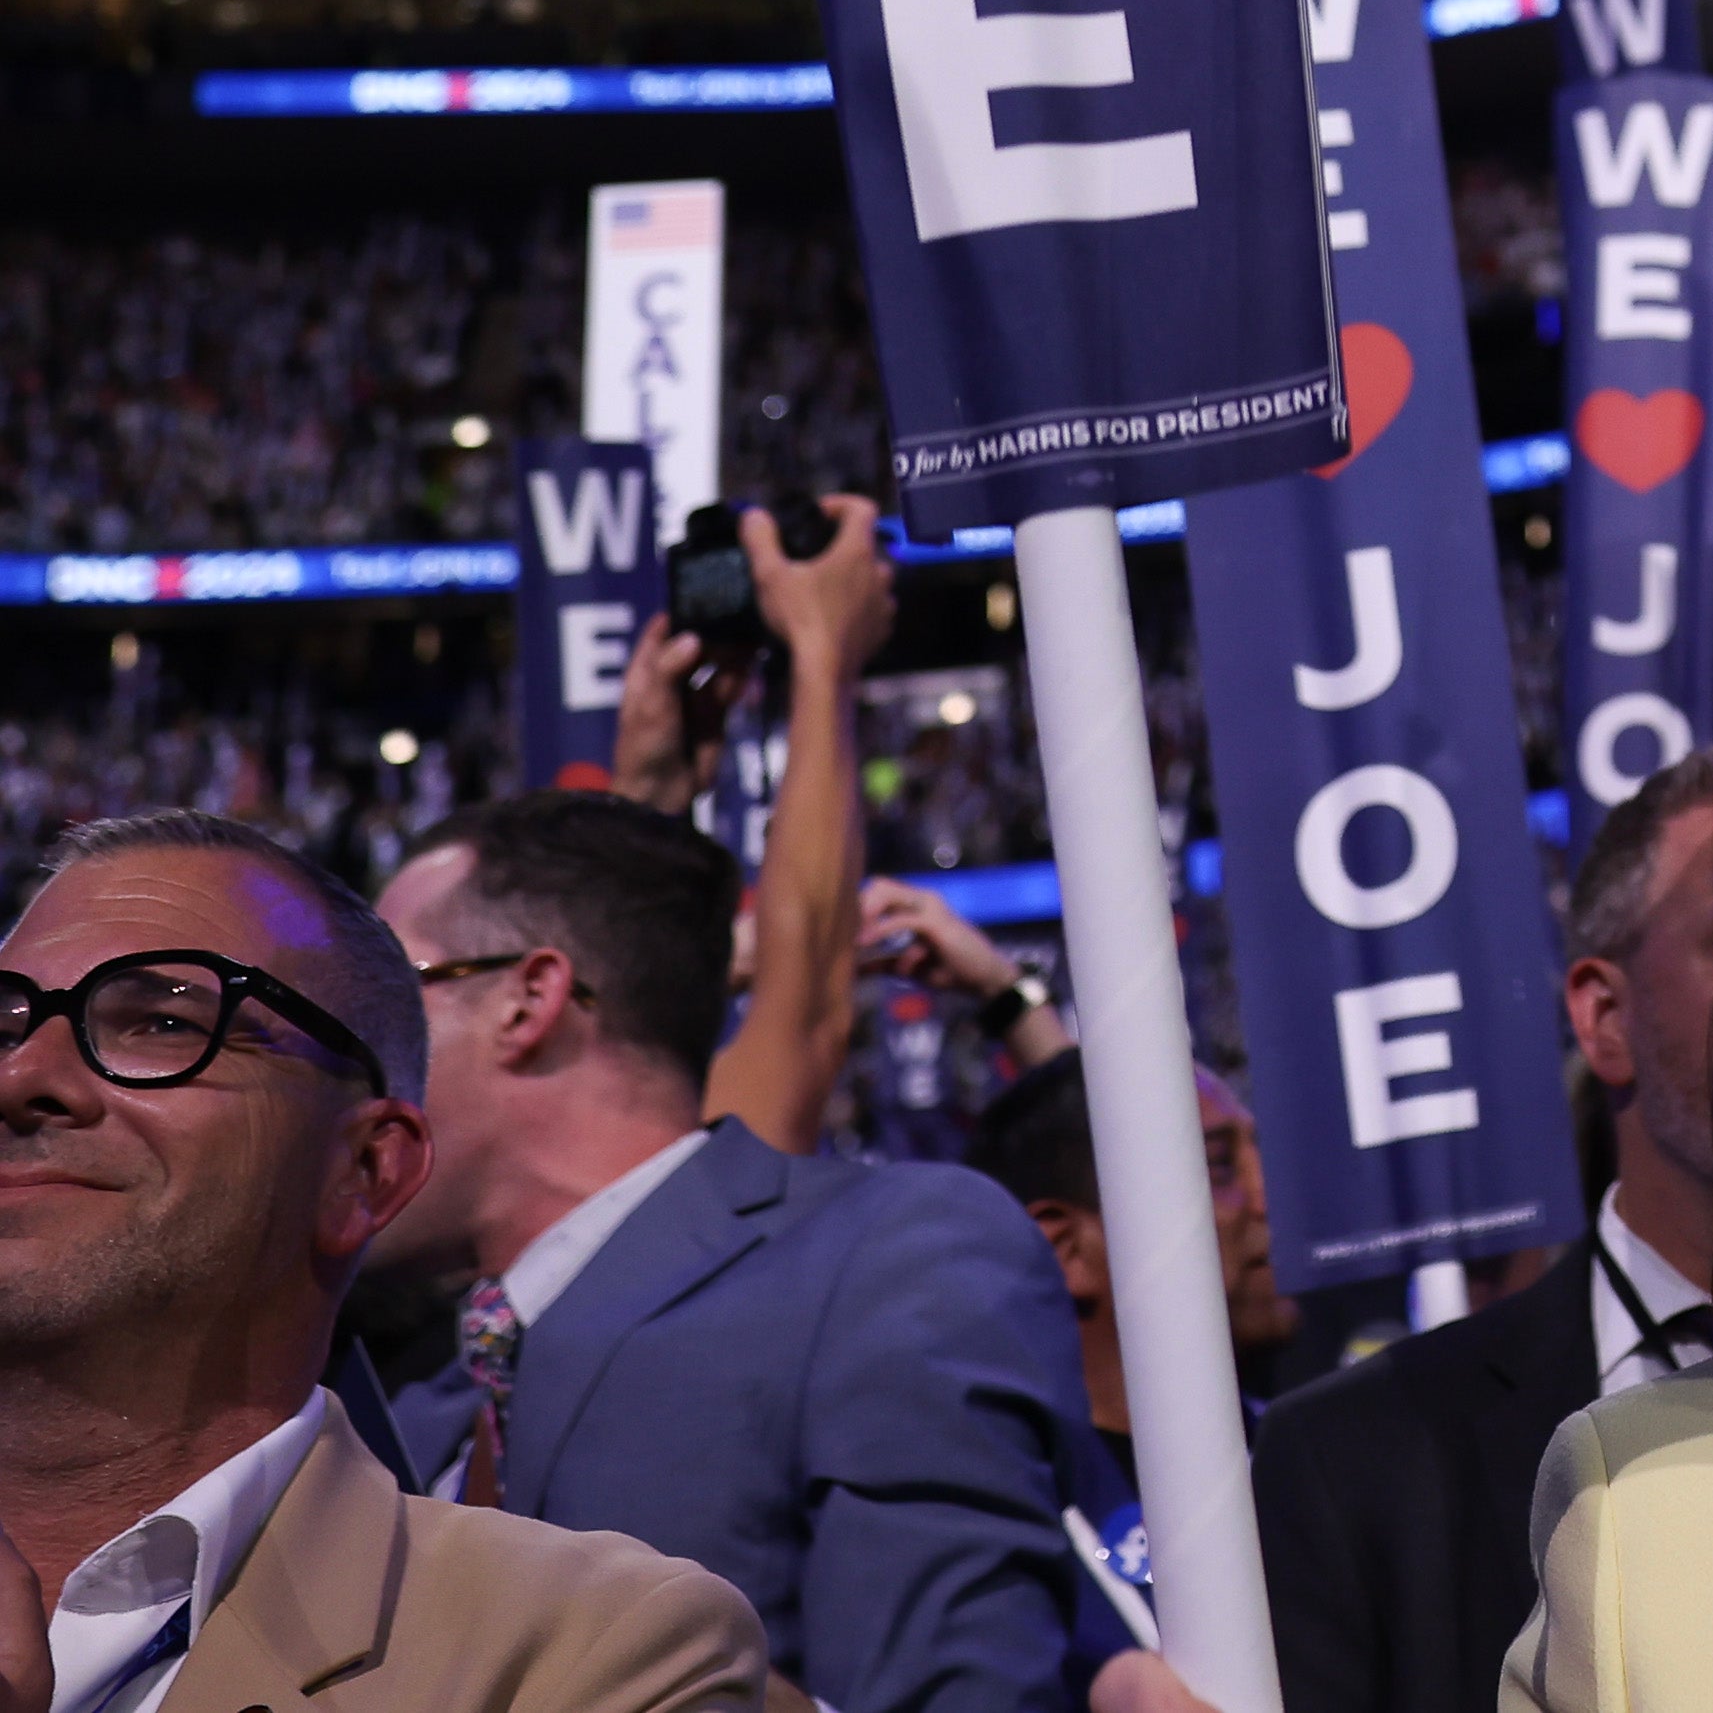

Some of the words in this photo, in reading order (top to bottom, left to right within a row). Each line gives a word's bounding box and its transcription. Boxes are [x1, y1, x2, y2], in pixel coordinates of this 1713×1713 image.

[978, 419, 1091, 464] HARRIS
[1096, 415, 1152, 444] FOR
[1156, 380, 1330, 439] PRESIDENT
[528, 467, 645, 714] WE
[1291, 544, 1481, 1151] JOE
